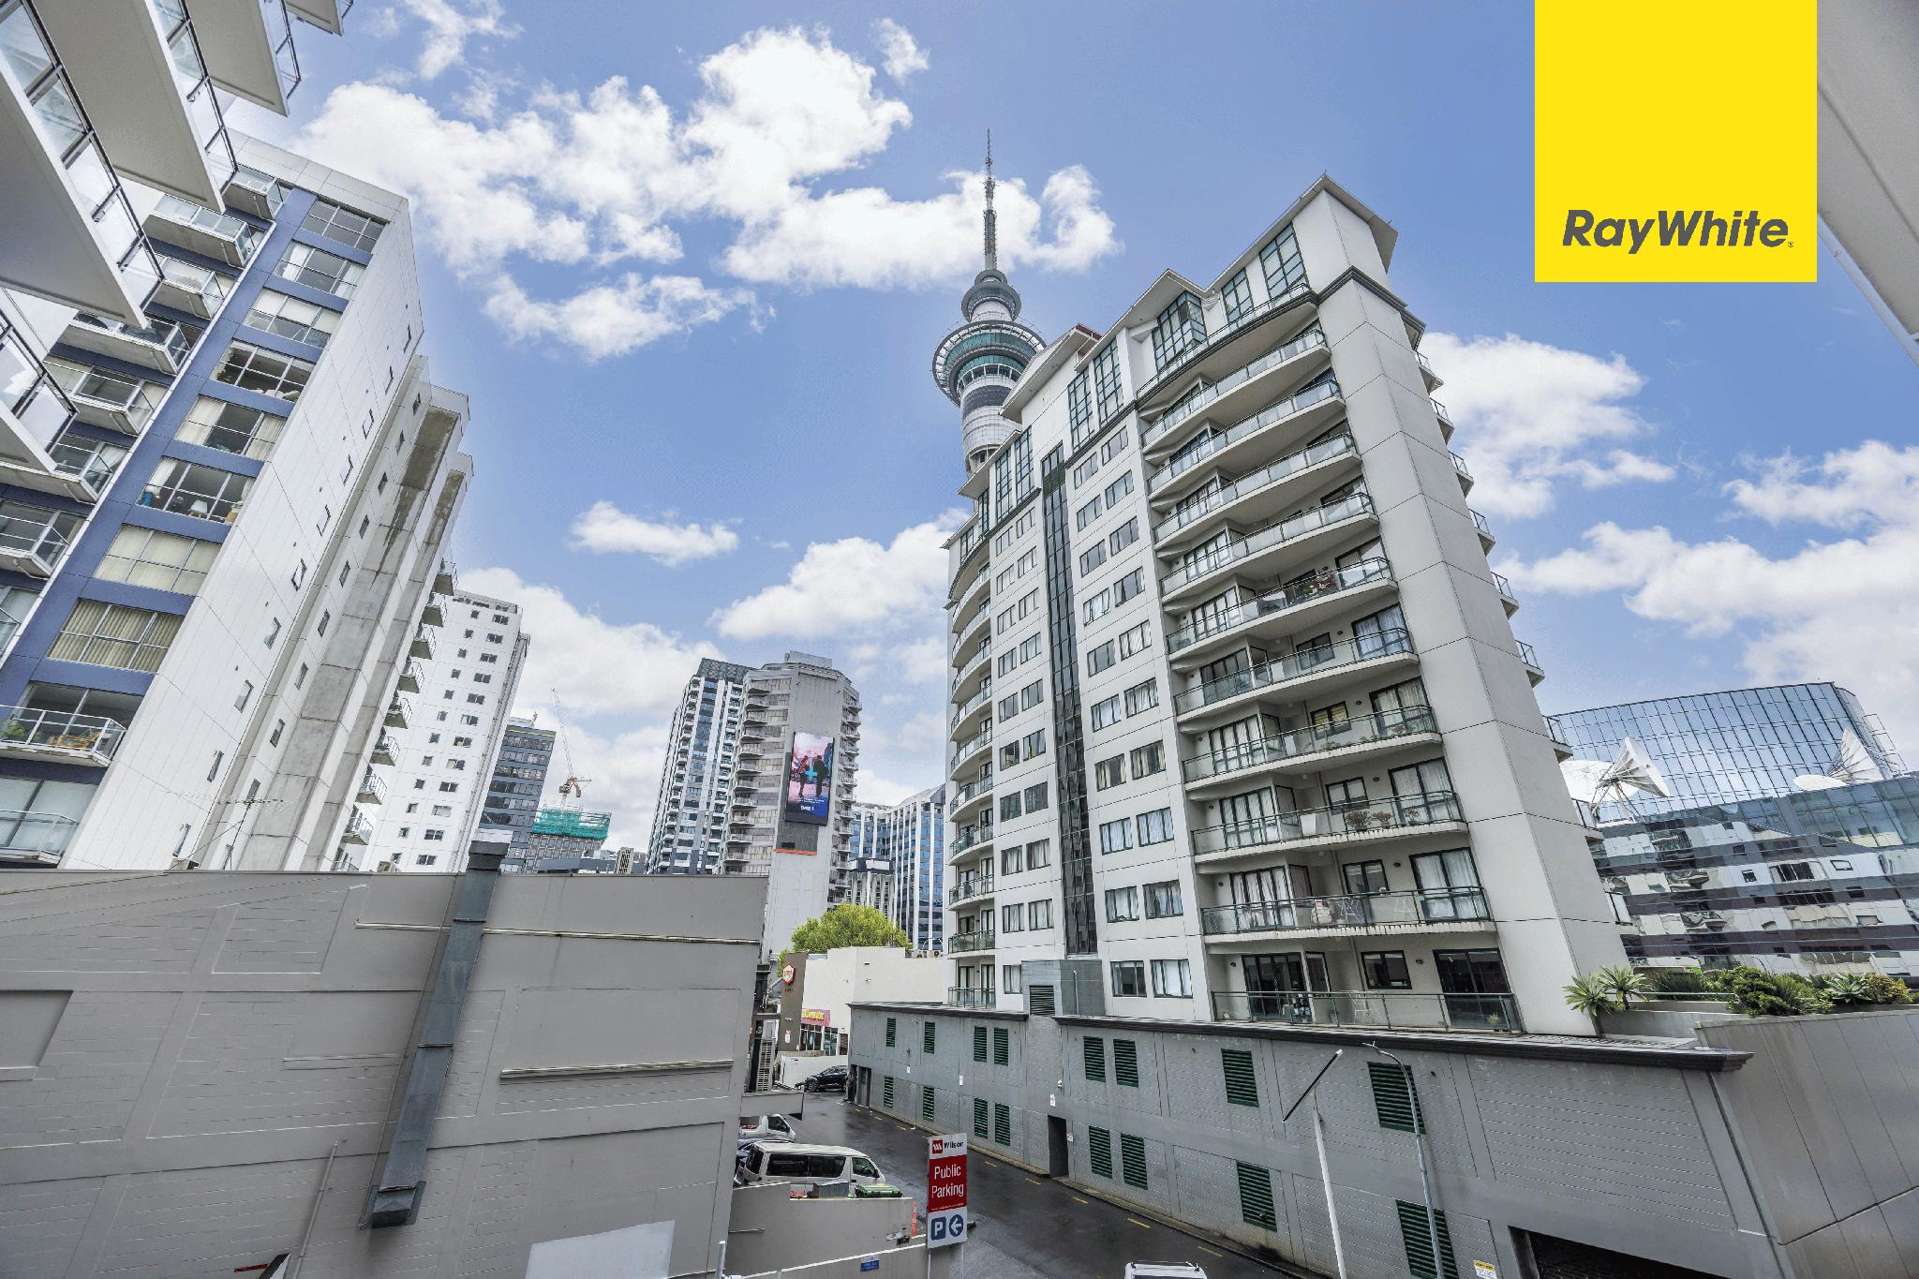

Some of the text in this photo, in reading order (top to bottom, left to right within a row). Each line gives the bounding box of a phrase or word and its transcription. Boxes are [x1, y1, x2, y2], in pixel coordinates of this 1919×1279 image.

[934, 1163, 962, 1180] Public
[931, 1182, 964, 1199] Parking
[934, 1221, 944, 1237] P
